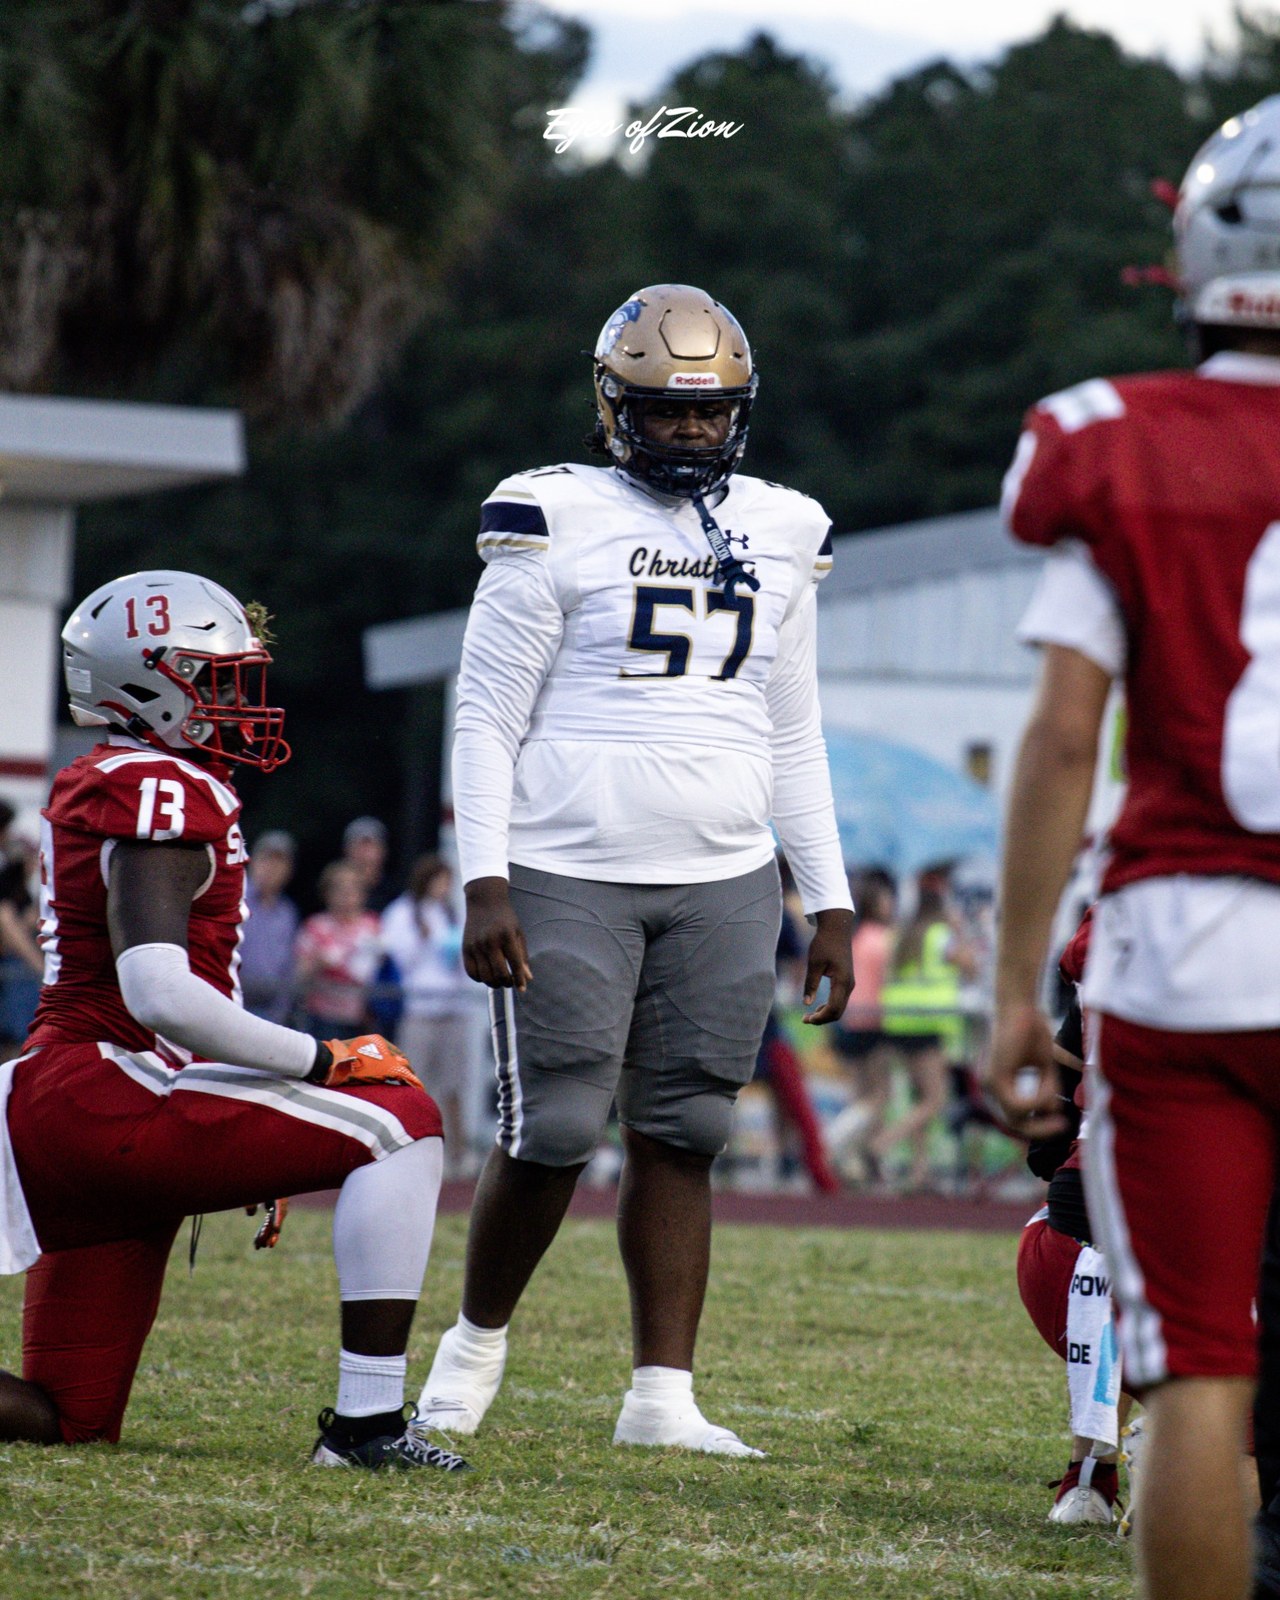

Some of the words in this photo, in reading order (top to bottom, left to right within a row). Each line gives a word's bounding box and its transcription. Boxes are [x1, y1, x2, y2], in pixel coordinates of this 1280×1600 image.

[125, 594, 171, 639] 13
[618, 583, 757, 681] 57
[136, 777, 186, 841] 13
[1069, 1342, 1092, 1364] DE
